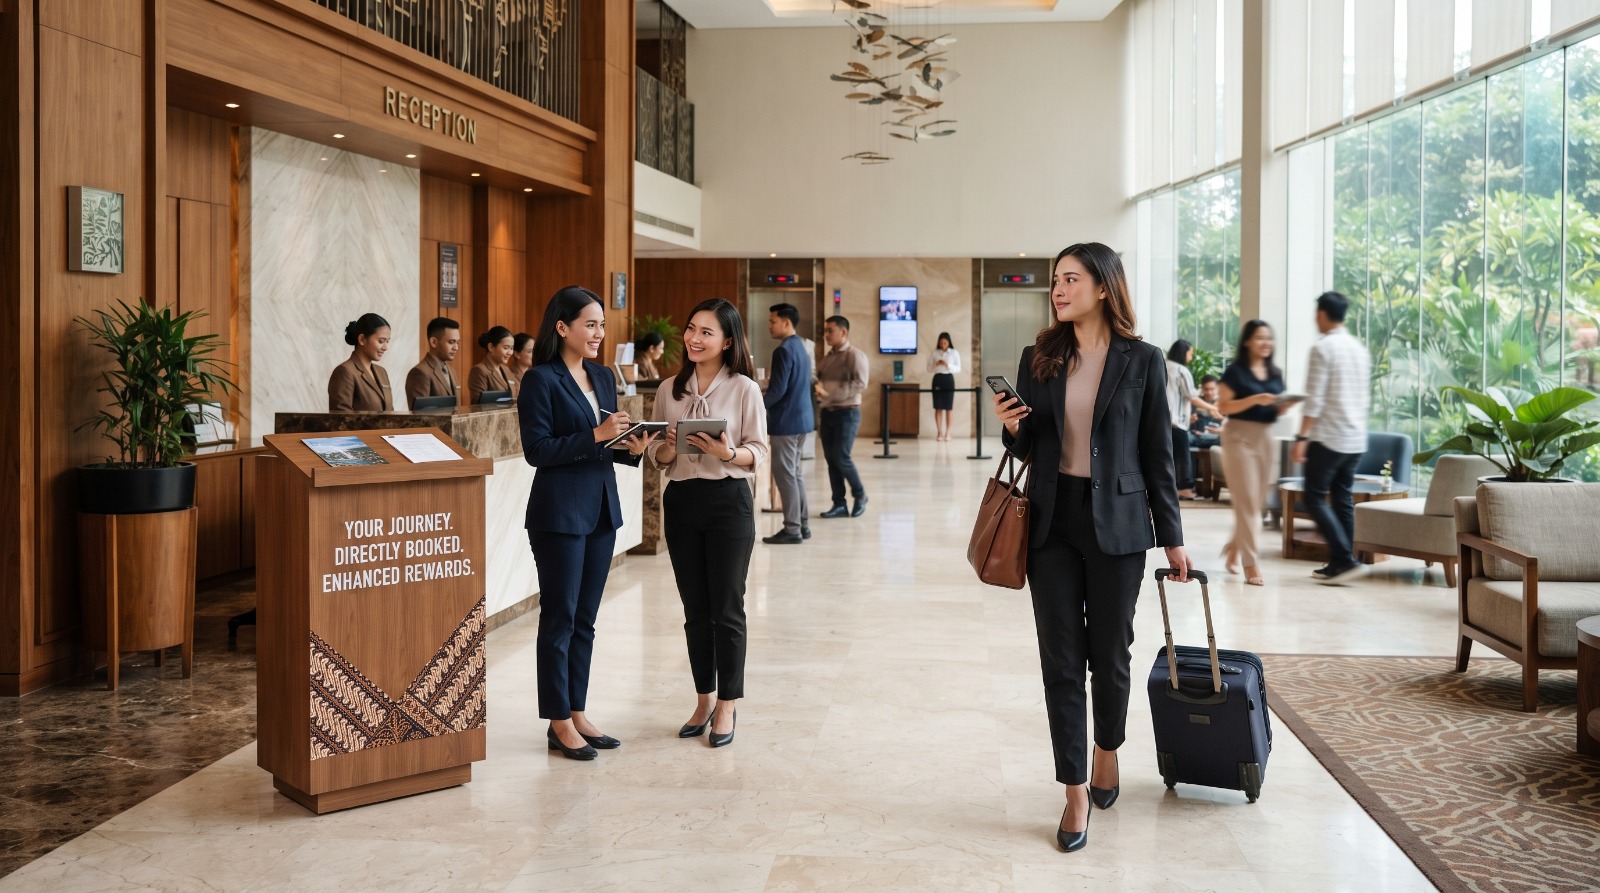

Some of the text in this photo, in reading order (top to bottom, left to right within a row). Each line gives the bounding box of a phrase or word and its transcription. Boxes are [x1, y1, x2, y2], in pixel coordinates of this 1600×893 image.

[384, 86, 477, 145] RECEPTION
[344, 512, 454, 540] YOUR JOURNEY.
[335, 535, 464, 566] DIRECTLY BOOKED.
[322, 558, 475, 593] ENHANCED REWARDS.
